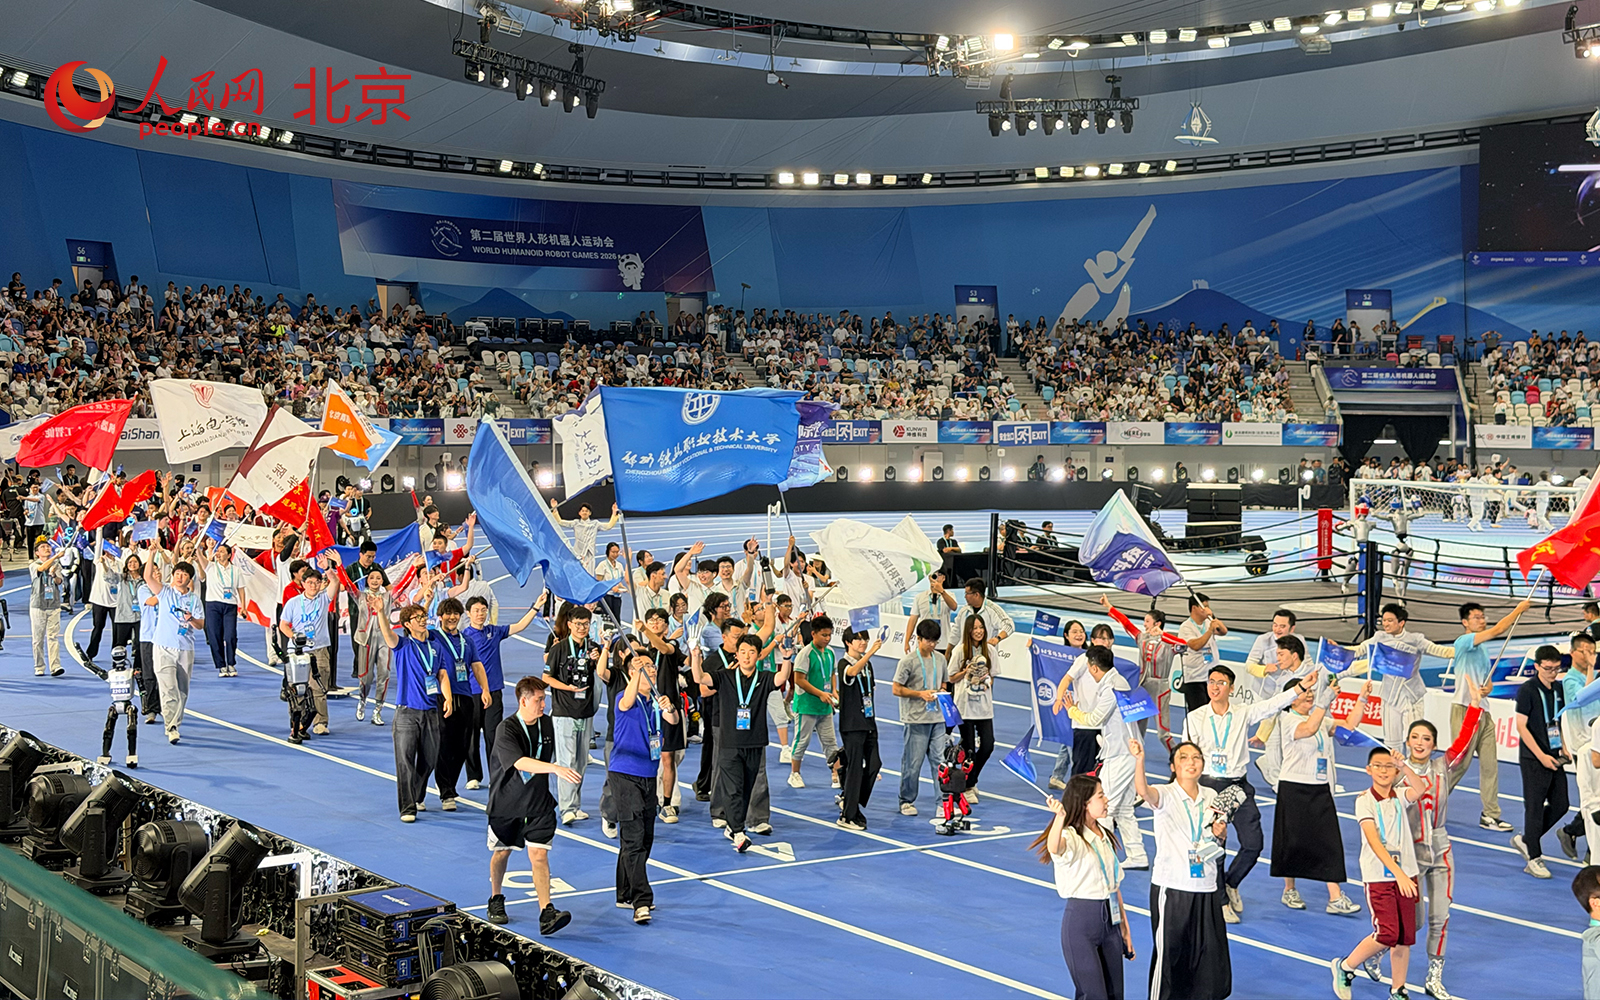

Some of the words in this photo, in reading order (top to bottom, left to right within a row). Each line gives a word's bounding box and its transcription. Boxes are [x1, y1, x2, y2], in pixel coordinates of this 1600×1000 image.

[470, 228, 614, 248] 第二届世界人形机器人运动会
[77, 246, 86, 255] S6
[472, 245, 500, 256] WORLD
[501, 247, 543, 258] HUMANOID
[545, 249, 570, 259] ROBOT
[572, 251, 599, 260] GAMES
[600, 252, 617, 261] 2026
[177, 415, 249, 442] 上海电学院
[511, 428, 525, 438] EXIT
[853, 428, 868, 437] EXIT
[120, 427, 161, 442] aiShan
[1032, 431, 1047, 440] EXIT
[179, 438, 209, 452] SHANGHAI
[714, 443, 743, 452] TECHNICAL
[744, 443, 778, 454] UNIVERSITY
[998, 648, 1011, 659] Cup
